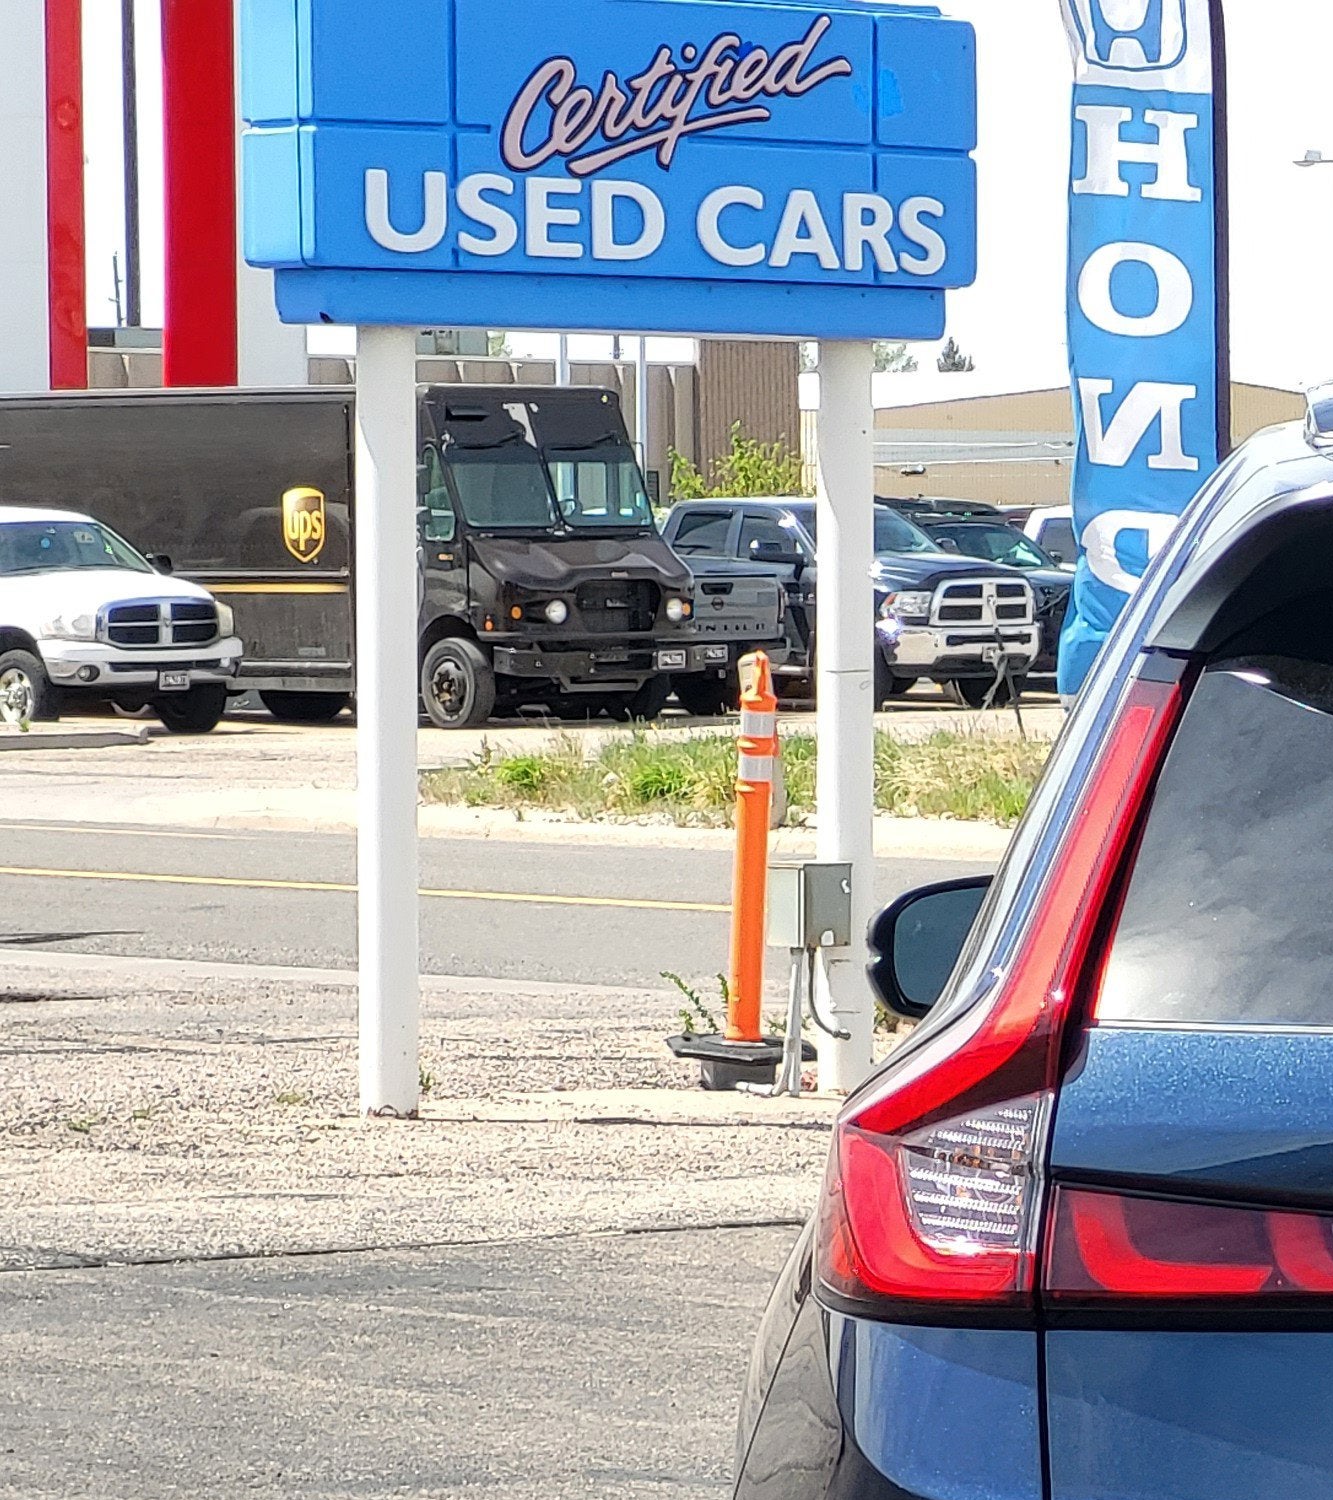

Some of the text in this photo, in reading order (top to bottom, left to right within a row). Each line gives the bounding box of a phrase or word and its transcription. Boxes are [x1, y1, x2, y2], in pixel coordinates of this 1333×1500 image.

[501, 14, 852, 177] Certified
[365, 168, 947, 276] USED CARS
[287, 510, 322, 551] ups
